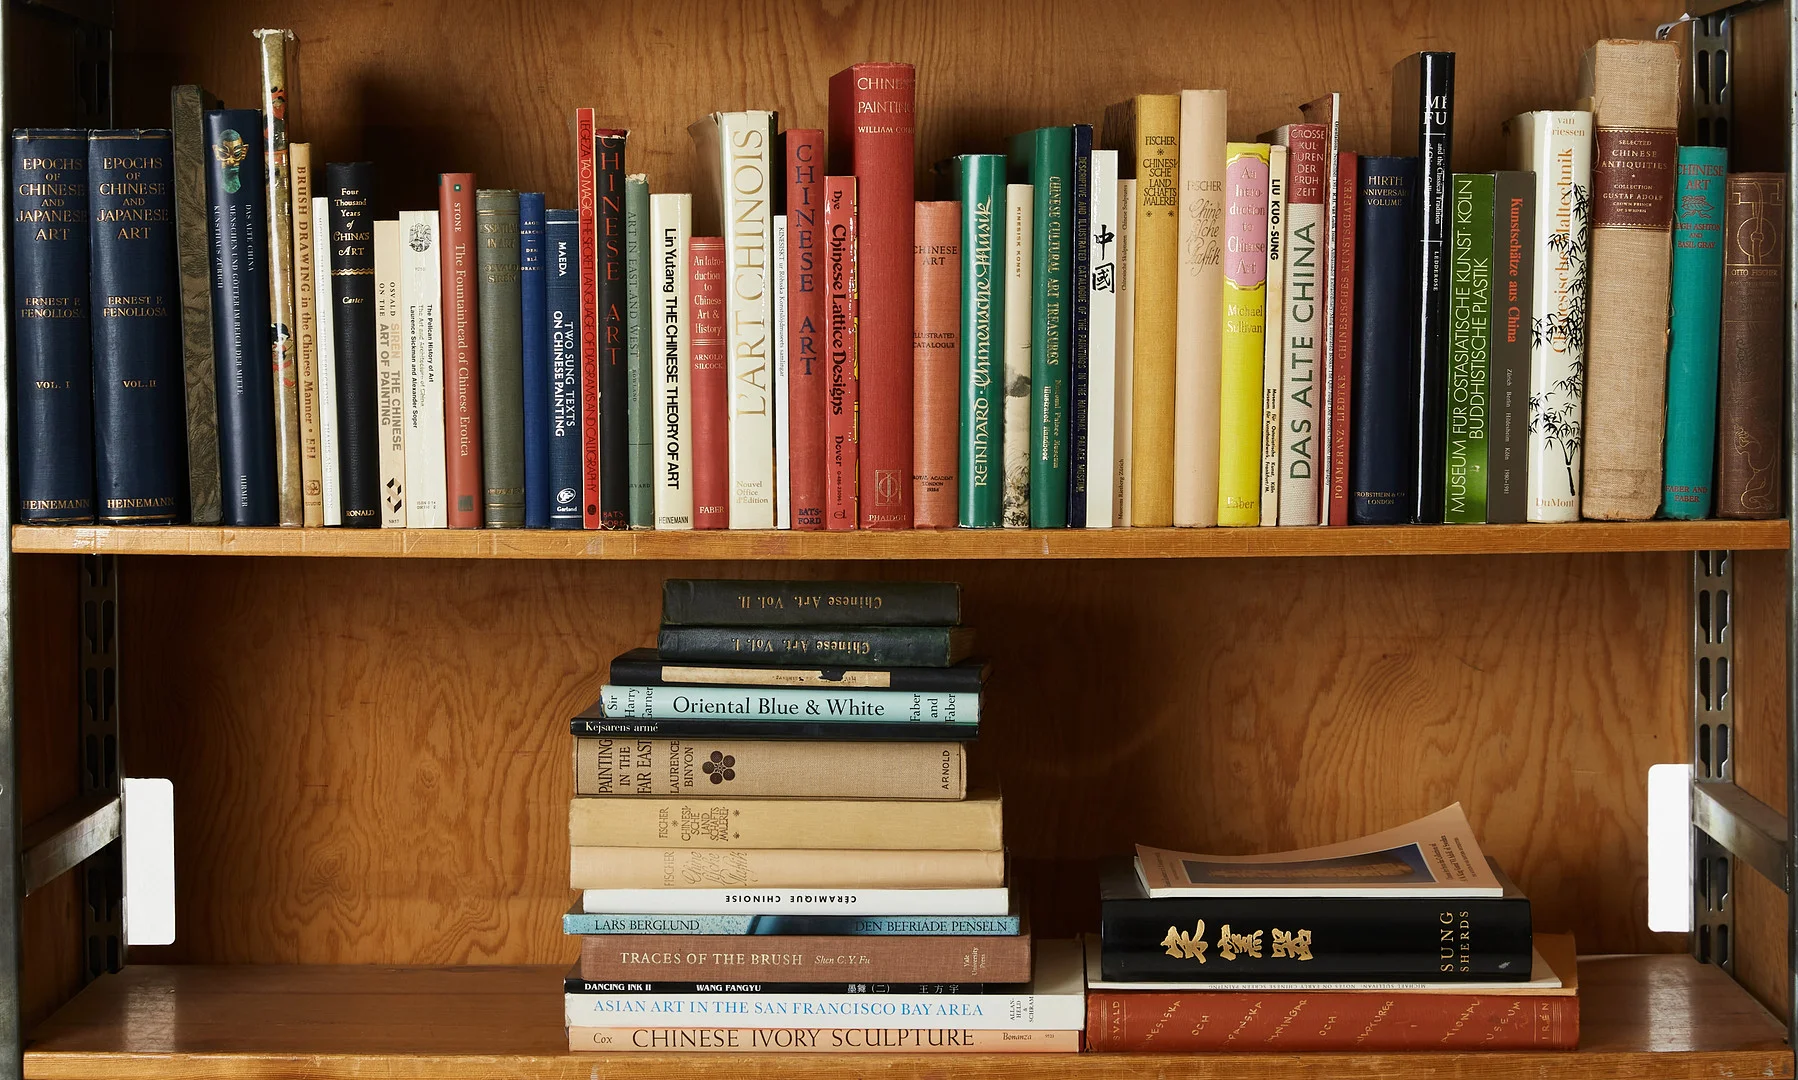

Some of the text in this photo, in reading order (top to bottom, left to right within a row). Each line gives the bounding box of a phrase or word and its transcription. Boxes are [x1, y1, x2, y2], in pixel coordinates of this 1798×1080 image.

[1144, 135, 1178, 146] FISCHER
[1618, 138, 1652, 146] SELECTED
[1291, 152, 1325, 162] TUREN
[1611, 149, 1658, 158] CHINESE
[22, 158, 84, 170] EPOCHS
[102, 157, 163, 170] EPOCHS
[581, 119, 592, 217] LEGEZA MAGIC
[1296, 164, 1316, 174] DER
[1601, 160, 1669, 170] ANTIQUITIES
[125, 172, 141, 180] OF
[1078, 156, 1088, 198] DESCRIPTIVE
[1148, 168, 1173, 178] SCHE
[18, 183, 86, 196] CHINESE
[98, 183, 167, 196] CHINESE
[1149, 178, 1173, 188] LAND
[1686, 179, 1711, 190] ART
[341, 188, 360, 196] Four
[1295, 187, 1318, 197] ZEIT
[1602, 192, 1665, 201] GUSTAF ADOLF
[41, 198, 65, 207] AND
[121, 198, 145, 206] AND
[334, 199, 367, 207] Thousand
[1366, 198, 1403, 207] VOLUME
[96, 209, 170, 222] JAPANESE
[340, 210, 361, 218] Years
[732, 128, 766, 303] CHINOIS
[297, 165, 312, 294] BRUSH DRAWING
[1047, 175, 1061, 273] CHINESE CULTURAL
[1241, 222, 1254, 232] to
[1269, 200, 1280, 261] KUO-SUNG
[35, 228, 71, 240] ART
[117, 227, 151, 239] ART
[338, 246, 365, 256] ART
[1227, 236, 1266, 253] Chinese
[558, 241, 568, 277] MAEDA
[795, 144, 817, 375] CHINESE ART
[921, 256, 946, 266] ART
[1093, 223, 1116, 294] 中國
[1506, 197, 1524, 343] Kunstschätze aus China
[25, 297, 70, 306] ERNEST
[106, 296, 151, 306] ERNEST
[102, 308, 168, 318] FENOLLOSA
[454, 202, 471, 457] STONE Fountainhead Chinese Erotica
[829, 190, 847, 467] Dye Chinese Lattice Designs Dover
[1289, 222, 1316, 480] DAS ALTE CHINA
[1451, 180, 1473, 513] MUSEUM FÜR OSTASIATISCHE KÖLN
[1468, 257, 1489, 439] BUDDHISTISCHE PLASTIK
[389, 281, 402, 451] OSVALD CHINESE
[663, 228, 680, 491] Lin Yutang THE CHINESE THEORY ART
[380, 323, 392, 426] ART OF PAINTING
[553, 310, 566, 437] ON CHINESE PAINTING
[972, 398, 990, 488] REINHARD
[22, 500, 91, 510] HEINEMANN
[106, 498, 176, 510] HEINEMANN
[699, 506, 725, 514] FABER
[657, 516, 690, 525] HEINEMANN
[868, 514, 907, 522] PHAIDON
[828, 595, 883, 609] Chinese
[816, 640, 871, 655] Chinese
[673, 696, 885, 716] Oriental Blue & White
[909, 693, 921, 722] Faber
[927, 698, 939, 719] and
[944, 693, 956, 722] Faber
[585, 721, 631, 734] Kejsarens
[619, 746, 631, 770] THE
[598, 738, 614, 794] PAINTING
[669, 740, 680, 794] LAURENCE
[684, 746, 694, 787] BINYON
[941, 749, 951, 790] ARNOLD
[637, 771, 652, 794] FAR
[701, 812, 711, 836] LAND
[724, 895, 858, 905] CÉRAMIQUE CHINOISE
[594, 919, 701, 931] LARS BERGLUND
[856, 921, 1008, 932] DEN PENSELN
[1440, 910, 1455, 973] SUNG
[1459, 910, 1470, 972] SHERDS
[621, 952, 803, 966] TRACES OF THE BRUSH
[859, 955, 872, 965] Fu
[971, 946, 979, 977] University
[585, 983, 761, 993] DANCING INK II WANG FANGYU
[592, 999, 984, 1017] ASIAN ART THE SAN FRANCISCO BAY AREA
[593, 1028, 1032, 1048] Cox CHINESE IVORY SCULPTURE Bonanza
